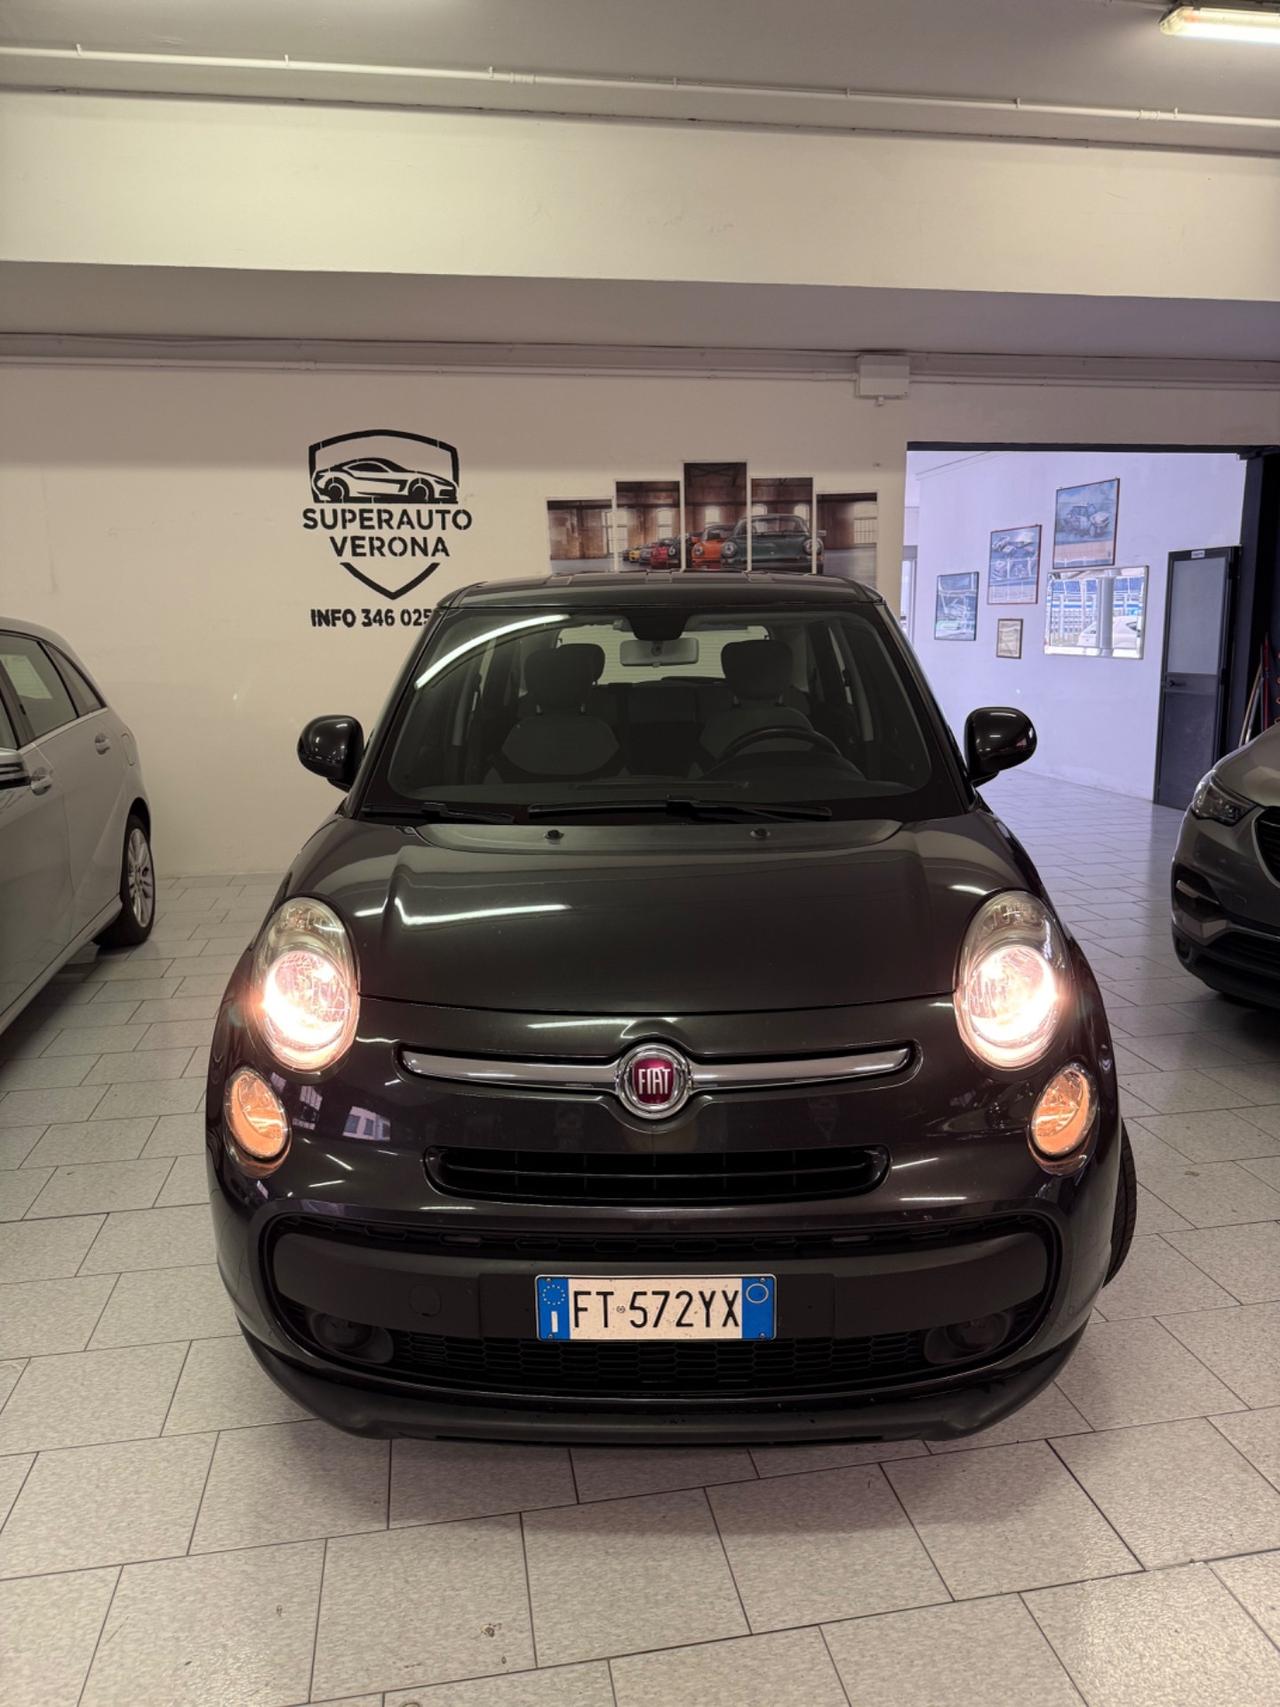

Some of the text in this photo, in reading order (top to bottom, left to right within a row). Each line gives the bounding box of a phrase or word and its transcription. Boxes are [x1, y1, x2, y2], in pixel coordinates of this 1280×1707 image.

[302, 508, 473, 531] SUPERAUTO
[329, 536, 451, 557] VERONA
[310, 608, 357, 628] INFO
[361, 608, 395, 627] 346
[638, 1066, 671, 1095] FIAT
